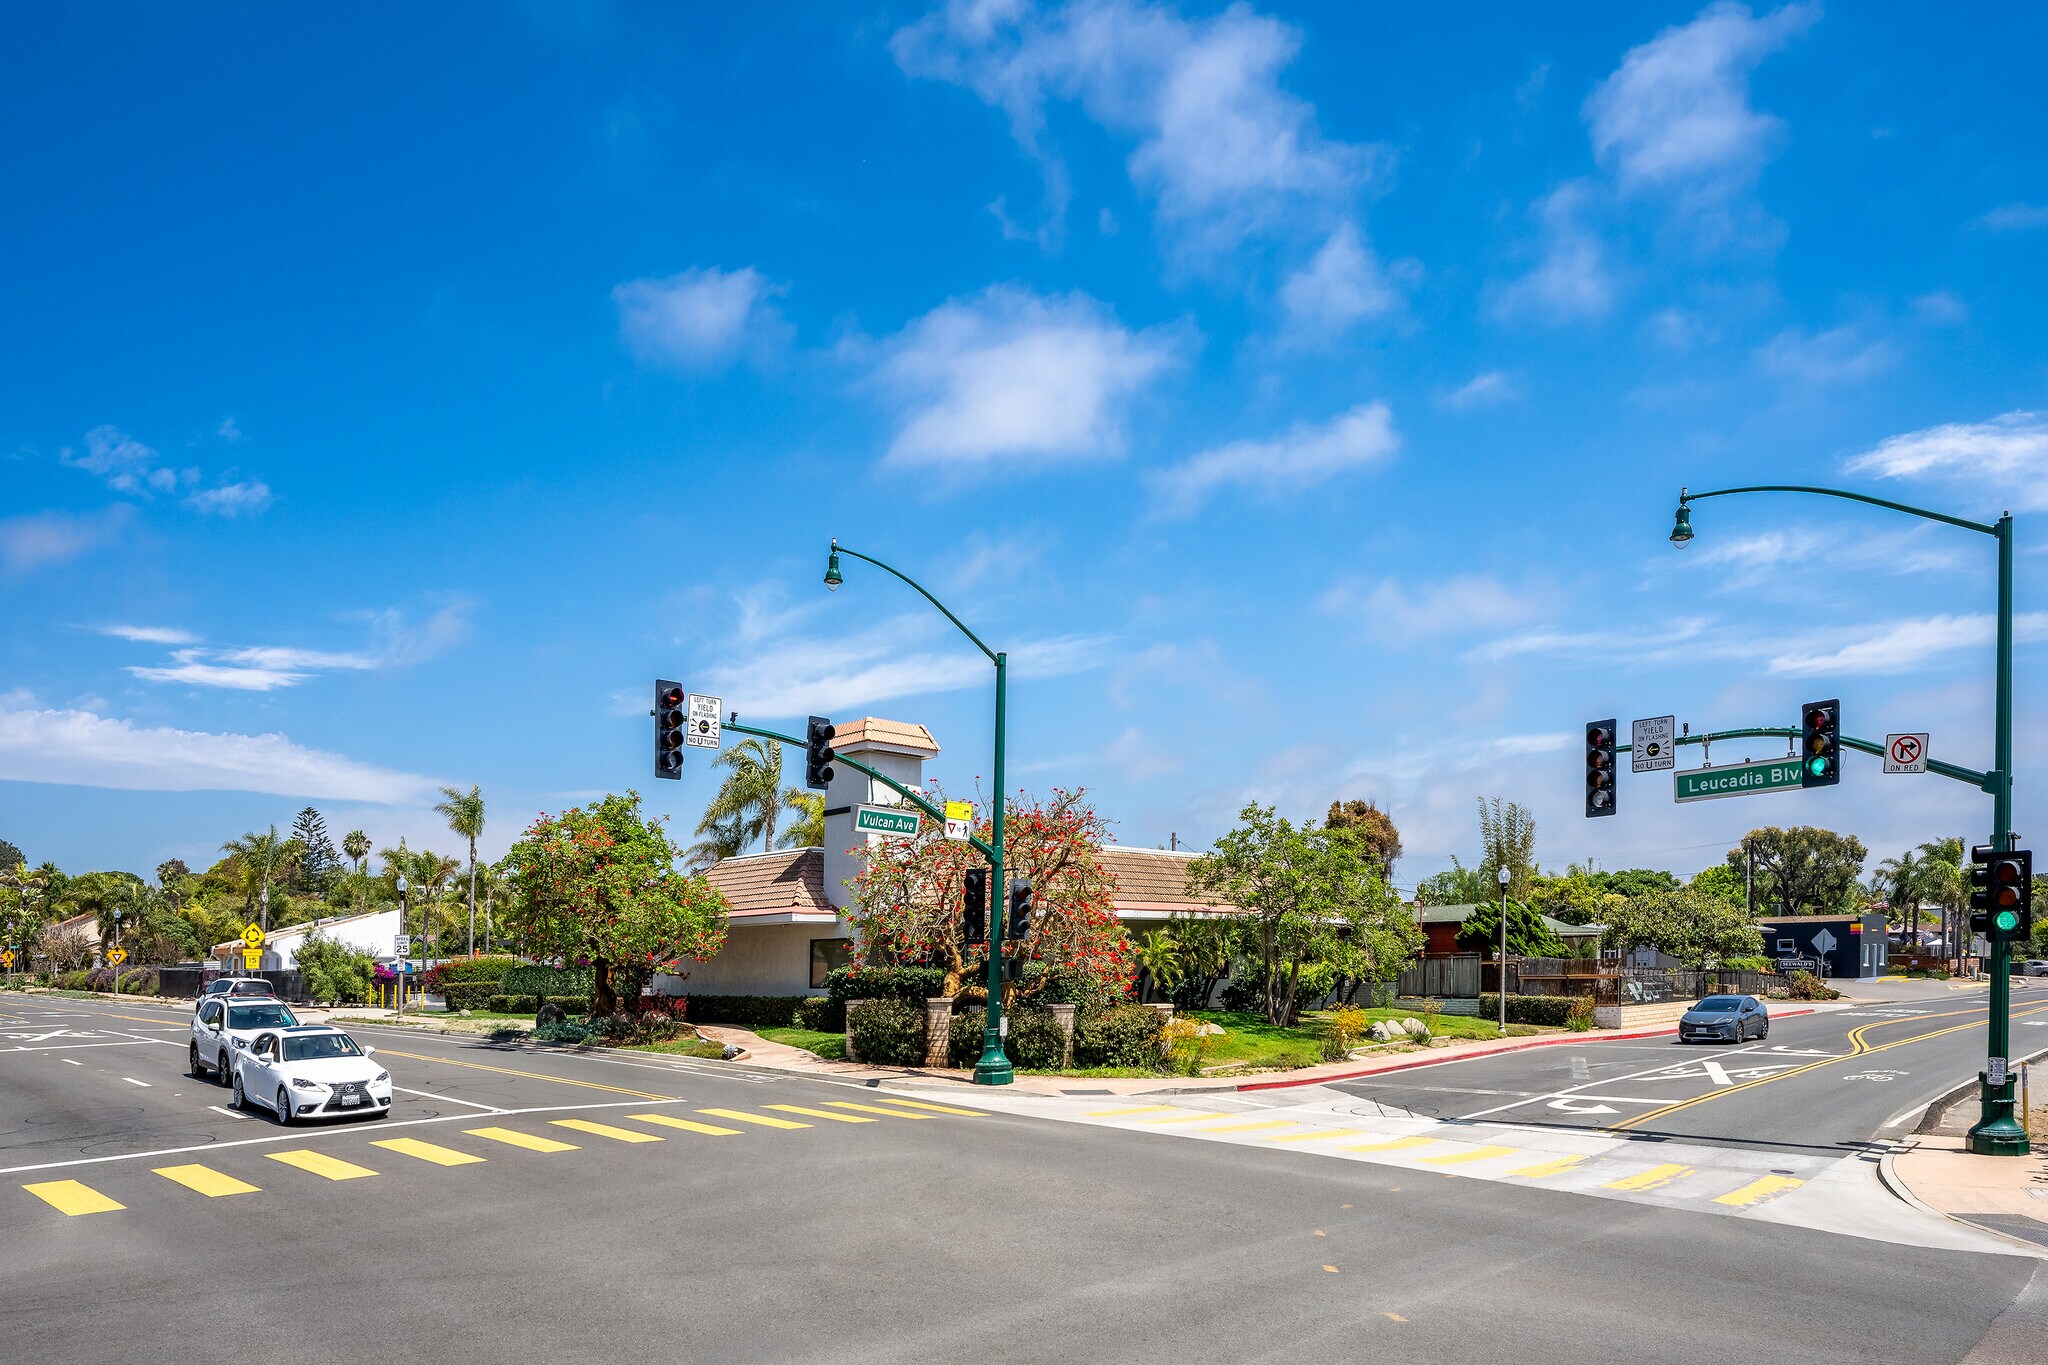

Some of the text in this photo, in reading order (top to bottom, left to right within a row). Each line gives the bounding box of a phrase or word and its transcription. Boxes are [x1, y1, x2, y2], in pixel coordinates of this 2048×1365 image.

[697, 704, 714, 712] YIELD
[1643, 726, 1664, 735] YIELD
[697, 737, 704, 745] U
[703, 738, 718, 746] TURN
[1645, 733, 1669, 741] FLASHING
[1646, 761, 1653, 769] U
[1654, 760, 1672, 768] TURN
[1688, 767, 1803, 793] Leucadia Blv
[863, 813, 914, 831] Vulcan Ave
[396, 945, 408, 953] 25
